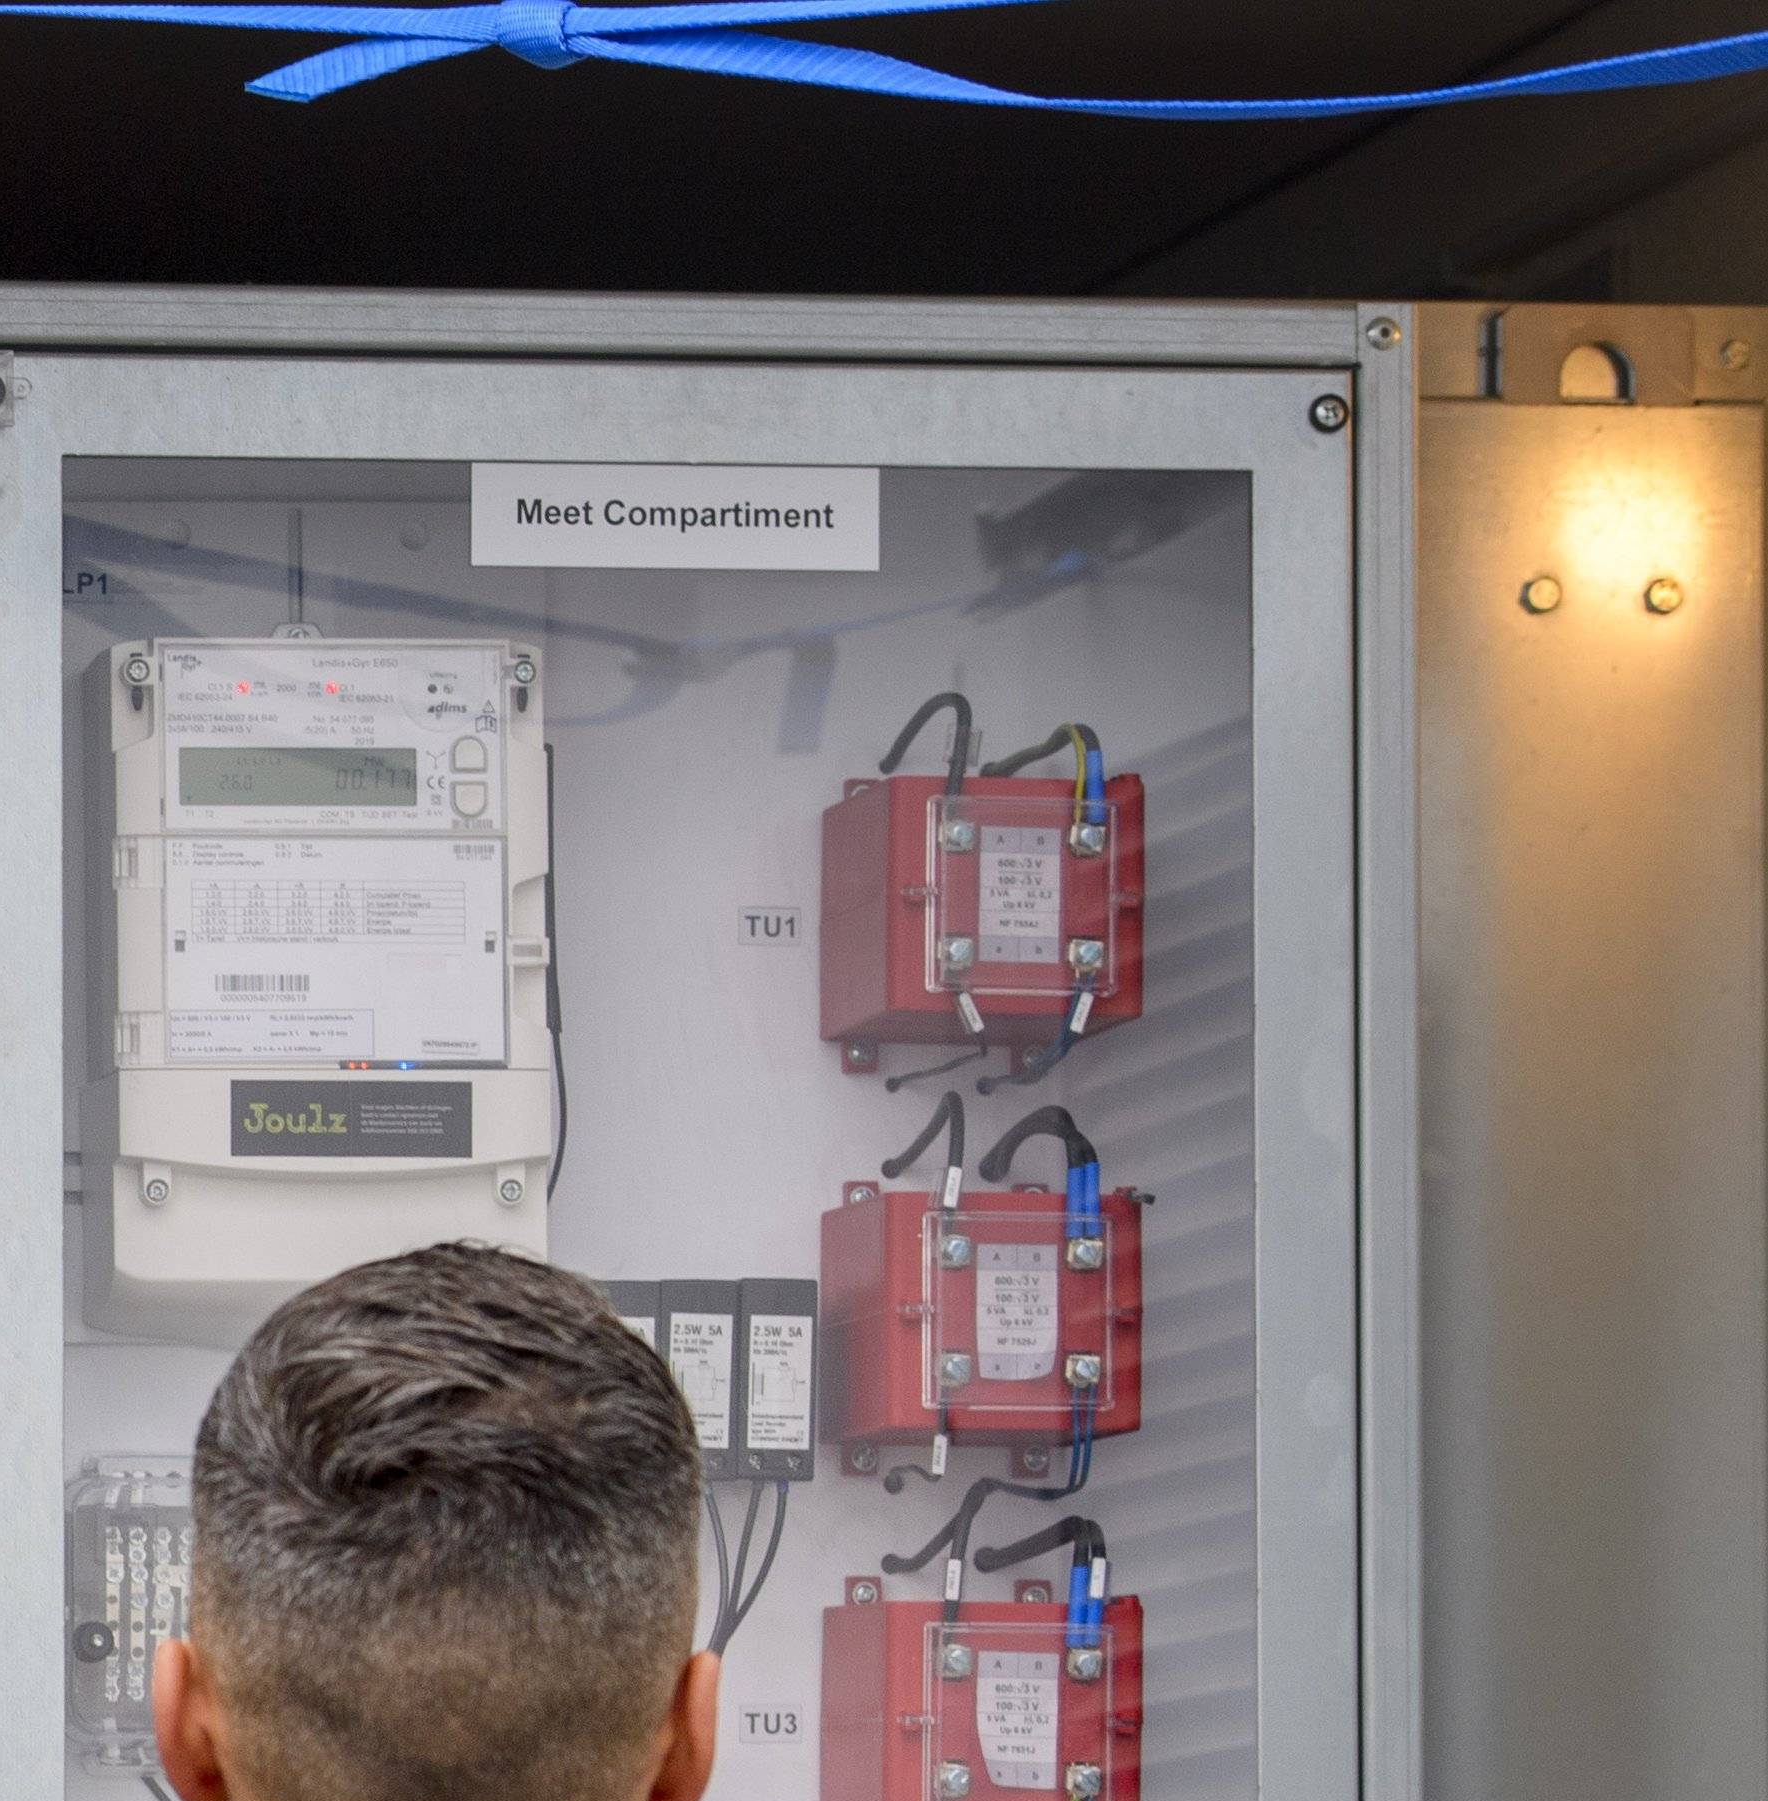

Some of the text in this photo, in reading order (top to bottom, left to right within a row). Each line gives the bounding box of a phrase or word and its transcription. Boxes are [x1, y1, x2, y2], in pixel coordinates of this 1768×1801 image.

[517, 498, 835, 534] Meet Compartiment
[745, 916, 797, 938] TU1
[244, 1103, 347, 1133] Joulz
[674, 1323, 723, 1337] 2.5W 5A
[754, 1325, 803, 1338] 2.5W 5A
[746, 1712, 798, 1735] TU3
